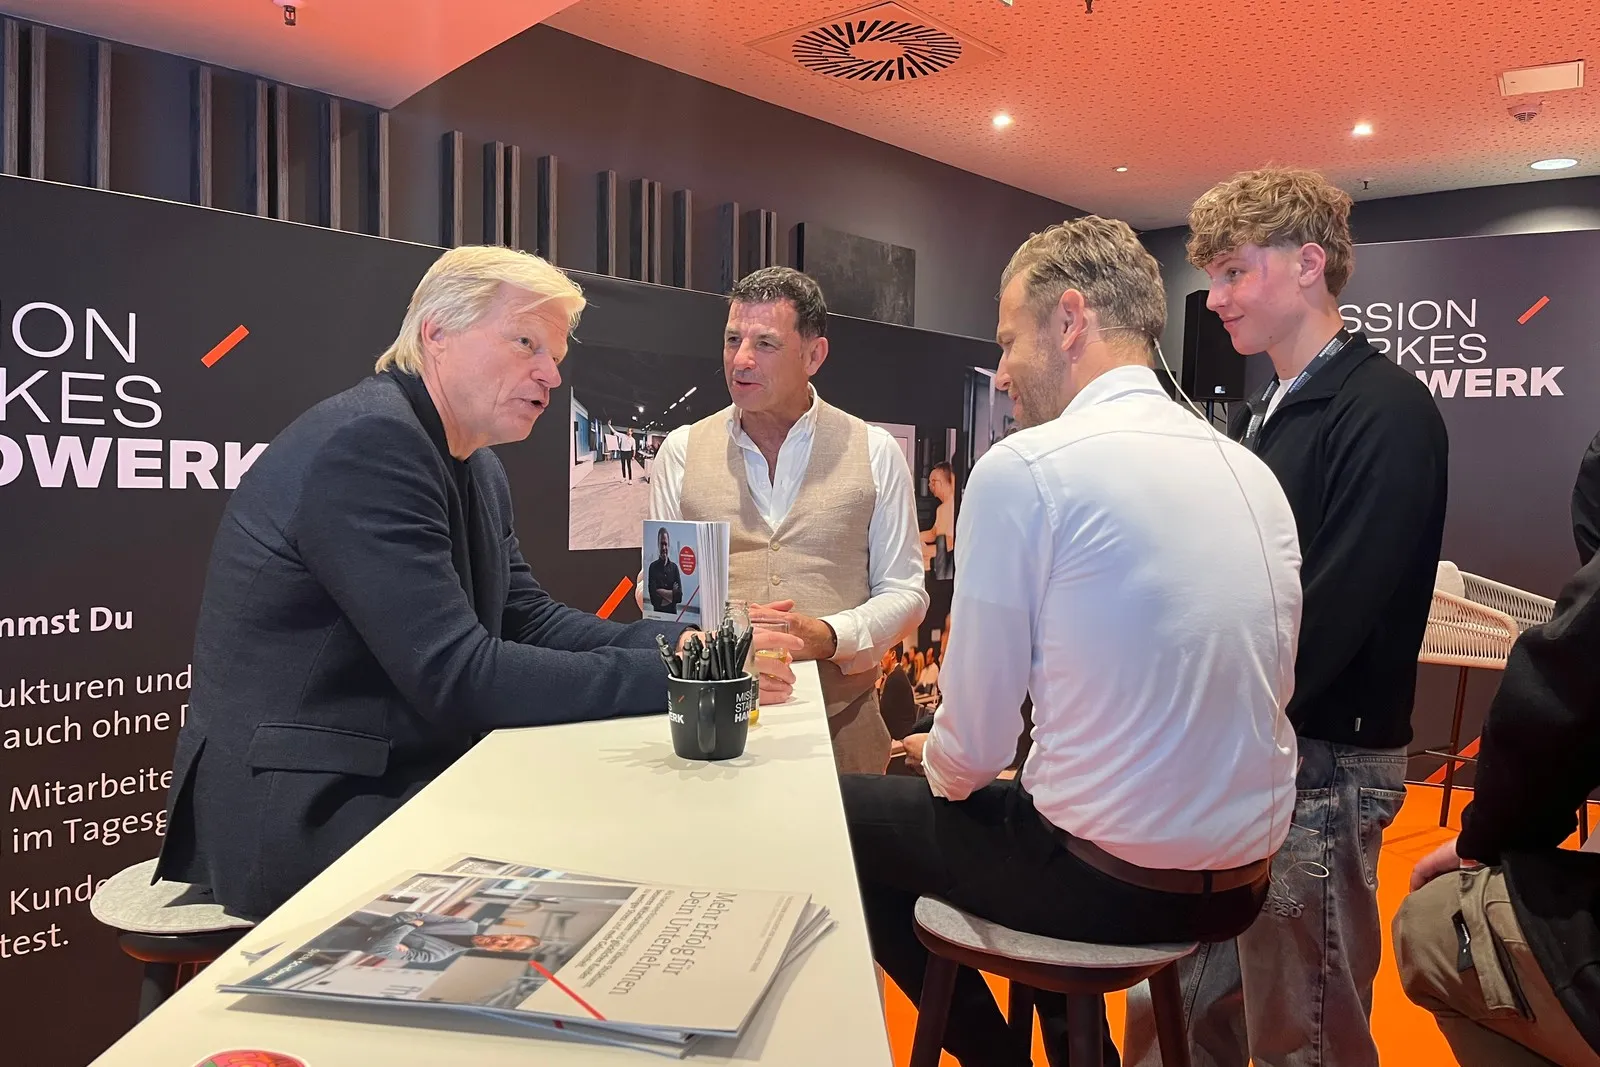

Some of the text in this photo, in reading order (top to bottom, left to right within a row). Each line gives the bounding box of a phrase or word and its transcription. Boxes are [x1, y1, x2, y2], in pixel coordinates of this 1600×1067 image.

[12, 302, 136, 363] ON
[90, 606, 133, 632] Du
[0, 664, 192, 708] ukturen und
[3, 716, 82, 749] auch
[92, 710, 170, 738] ohne
[12, 828, 52, 853] im
[0, 923, 69, 958] test.
[608, 891, 711, 995] Dein Unternehmen
[662, 892, 738, 976] Mehr Erfolg für
